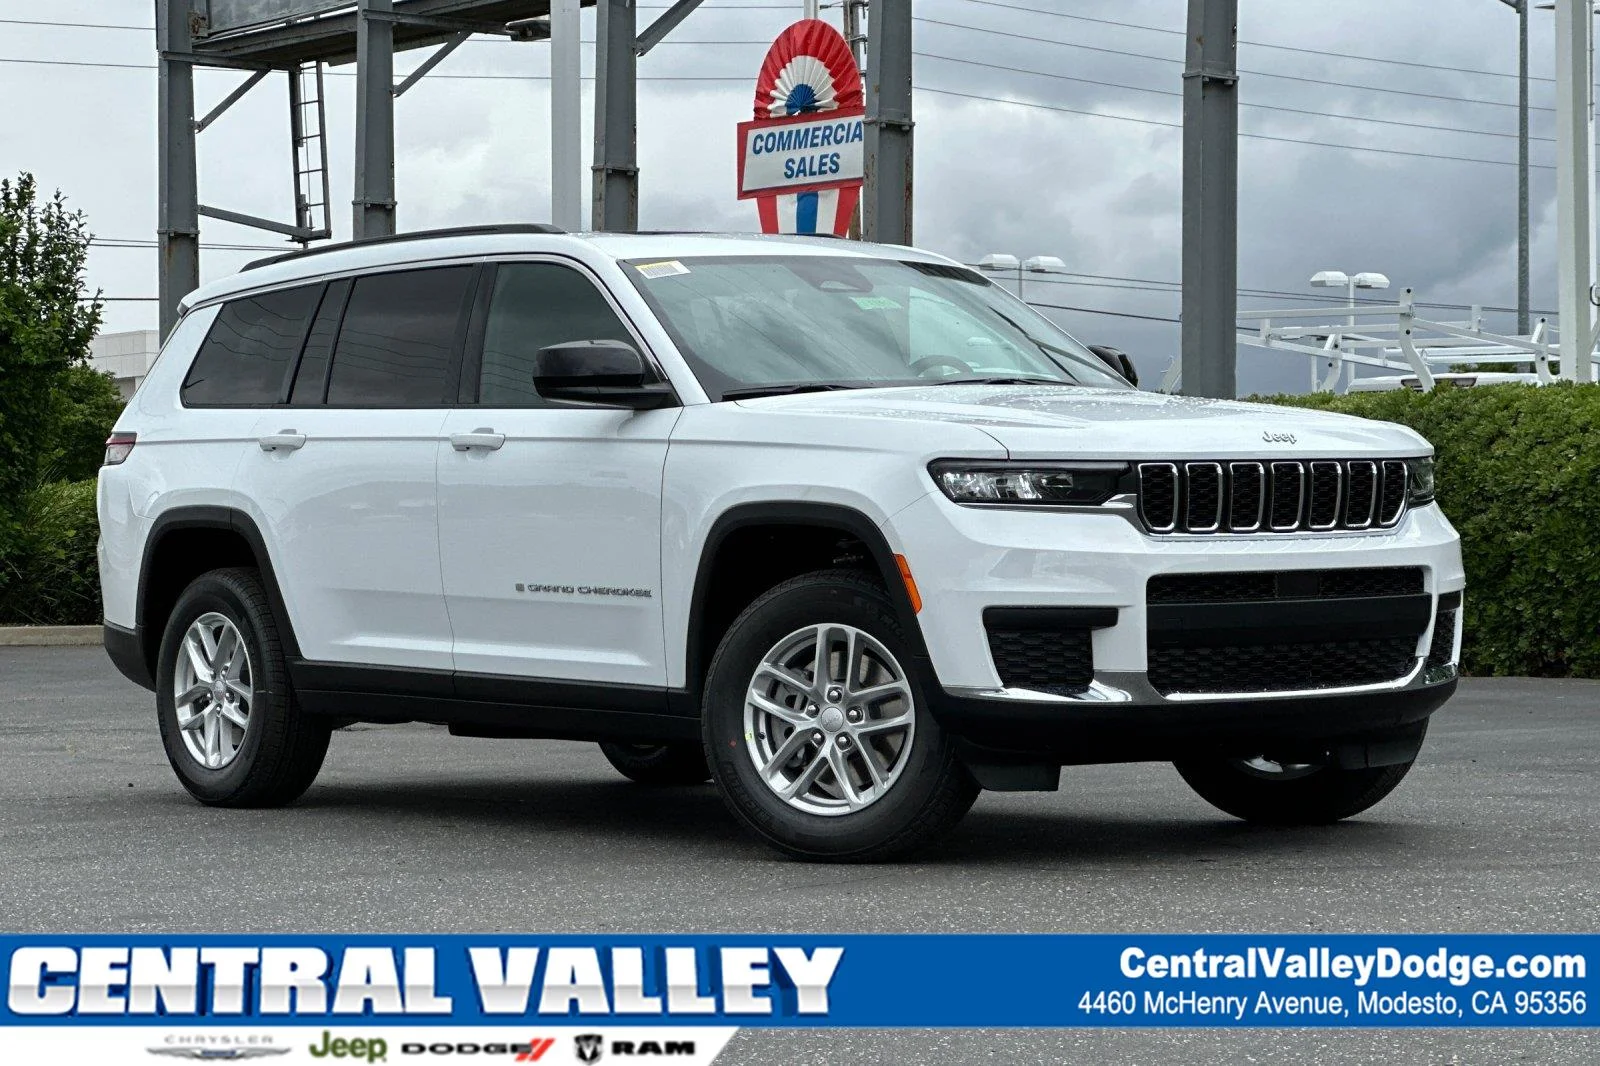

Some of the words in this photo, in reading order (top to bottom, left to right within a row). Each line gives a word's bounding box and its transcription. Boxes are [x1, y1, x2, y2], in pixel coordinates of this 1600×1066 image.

[752, 120, 863, 155] COMMERCIA
[784, 152, 840, 179] SALES
[1262, 431, 1297, 445] Jeep
[527, 583, 575, 594] GRAND
[577, 586, 652, 598] CHEROKEE
